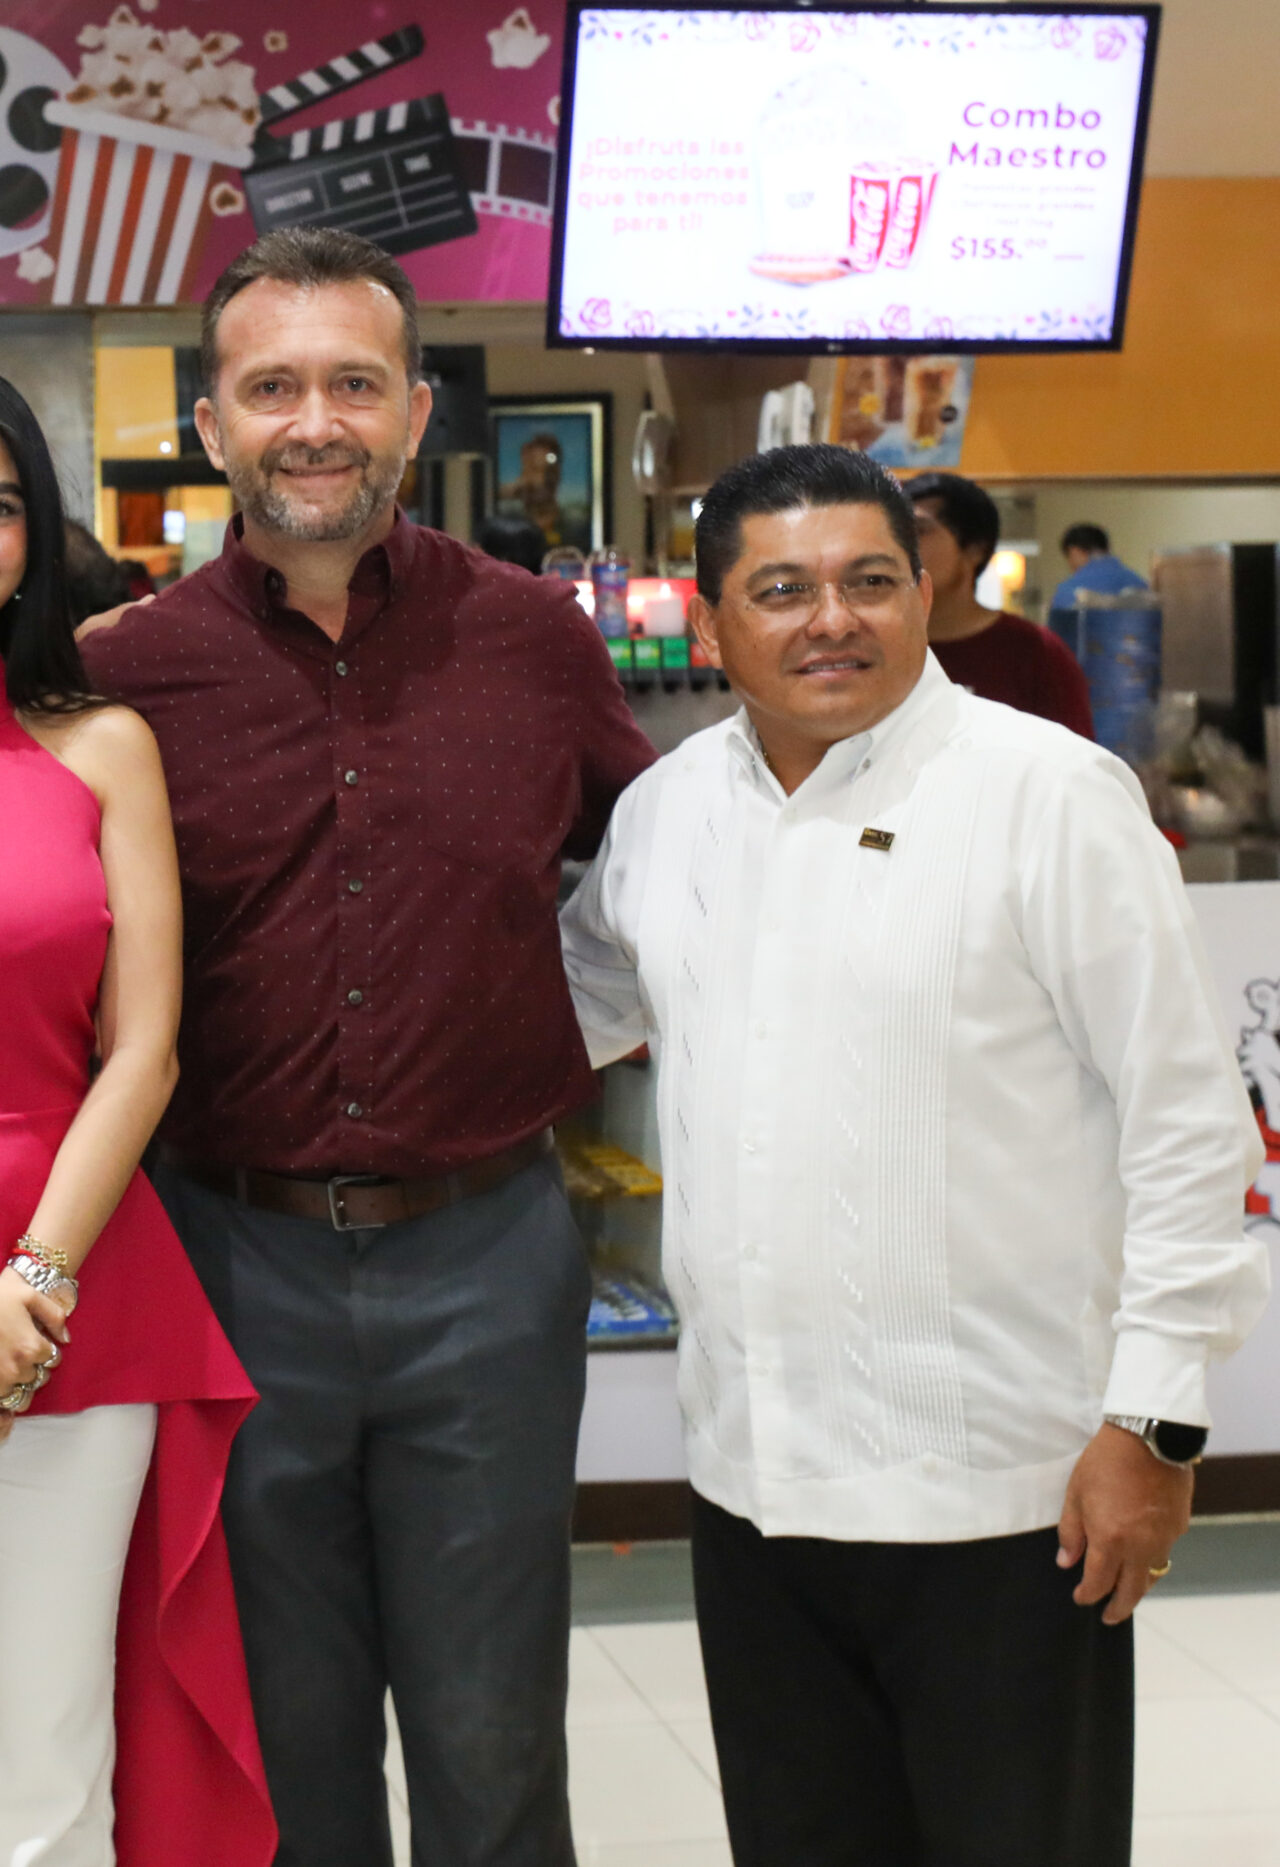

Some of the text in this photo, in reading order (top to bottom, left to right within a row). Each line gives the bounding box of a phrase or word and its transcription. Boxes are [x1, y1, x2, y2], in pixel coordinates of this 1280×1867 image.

[962, 101, 1102, 130] Combo
[709, 136, 745, 155] las
[948, 142, 1107, 169] Maestro
[578, 160, 750, 181] Promociones
[577, 189, 748, 212] que tenemos
[613, 216, 669, 236] para
